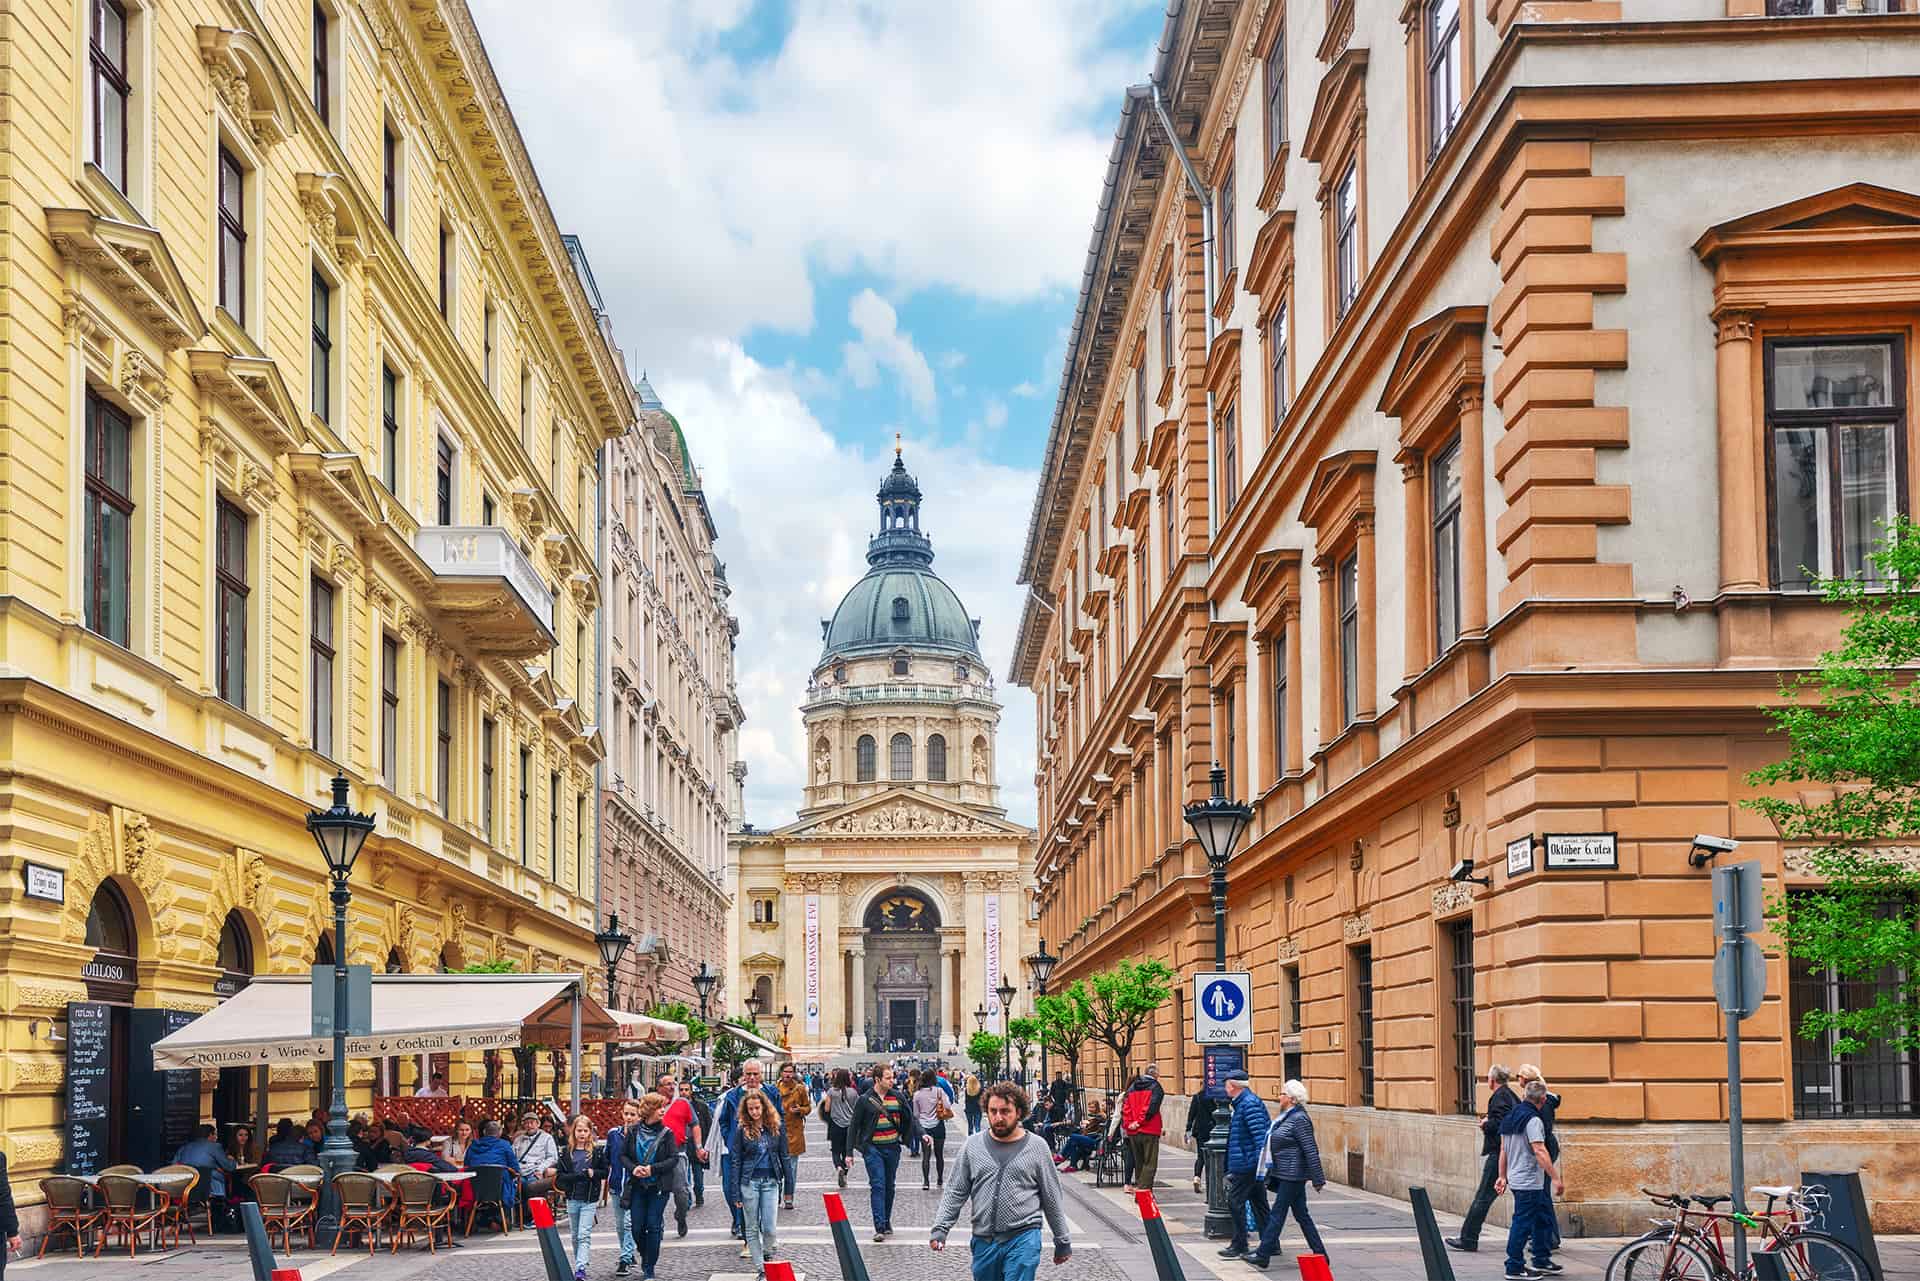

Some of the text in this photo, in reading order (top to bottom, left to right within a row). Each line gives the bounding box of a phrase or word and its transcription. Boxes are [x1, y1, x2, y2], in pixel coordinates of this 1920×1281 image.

[1594, 844, 1611, 855] utca
[278, 1046, 309, 1057] Wine
[344, 1041, 371, 1053] offee
[396, 1036, 443, 1050] Cocktail
